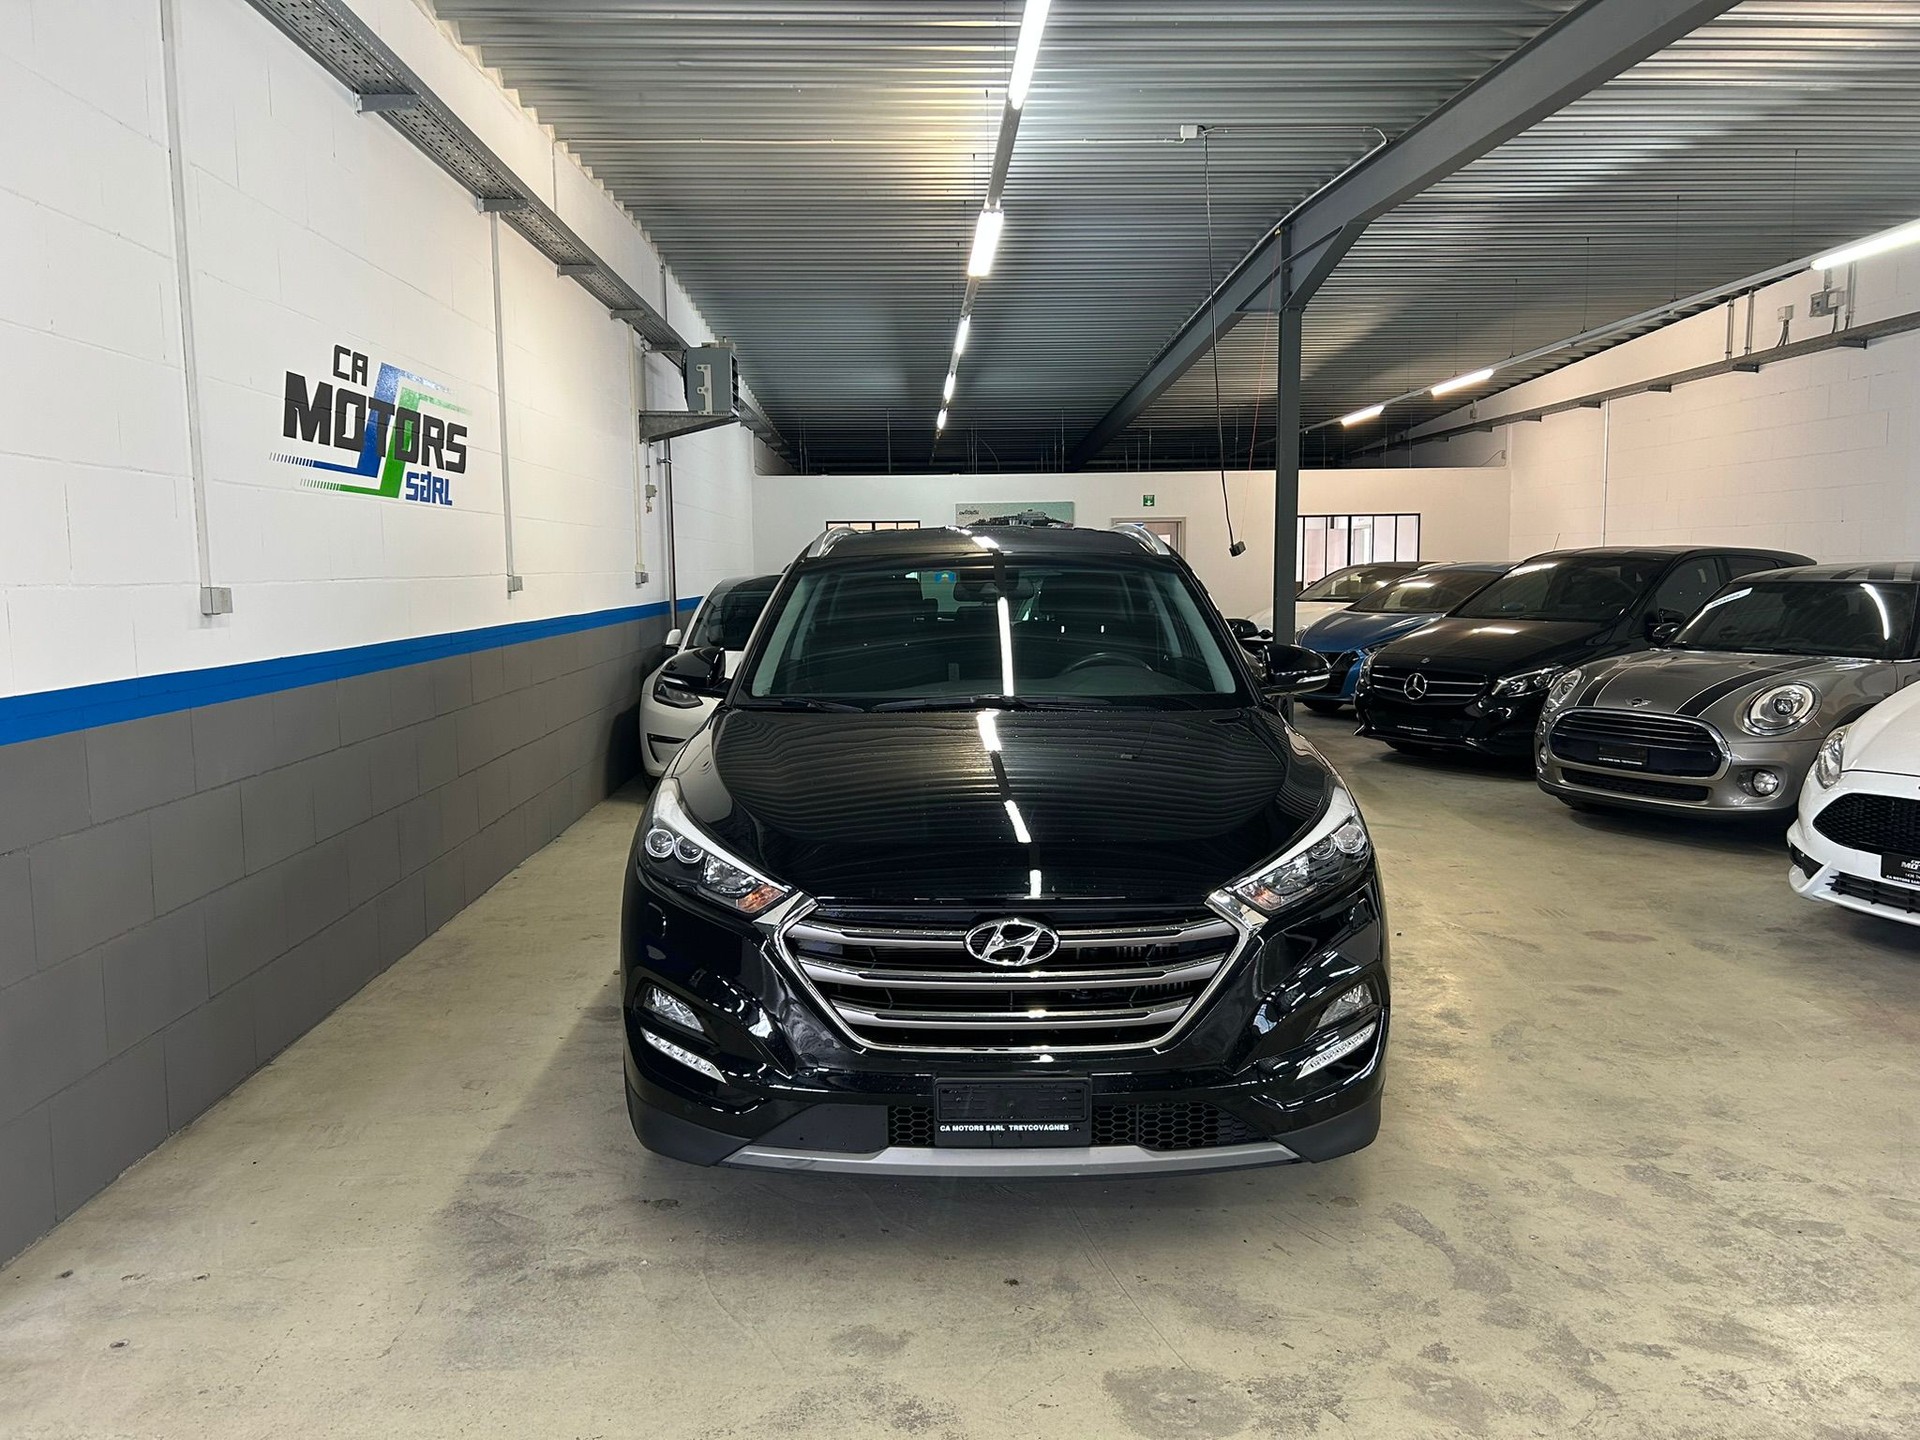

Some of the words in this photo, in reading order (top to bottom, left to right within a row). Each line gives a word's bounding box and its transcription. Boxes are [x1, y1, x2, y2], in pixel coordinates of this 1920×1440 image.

[333, 344, 369, 387] CA
[283, 370, 468, 474] MOTORS
[940, 1124, 951, 1132] CA
[952, 1124, 984, 1132] MOTORS
[985, 1124, 1005, 1132] SARL
[1009, 1124, 1070, 1132] TREYCOVAGNES
